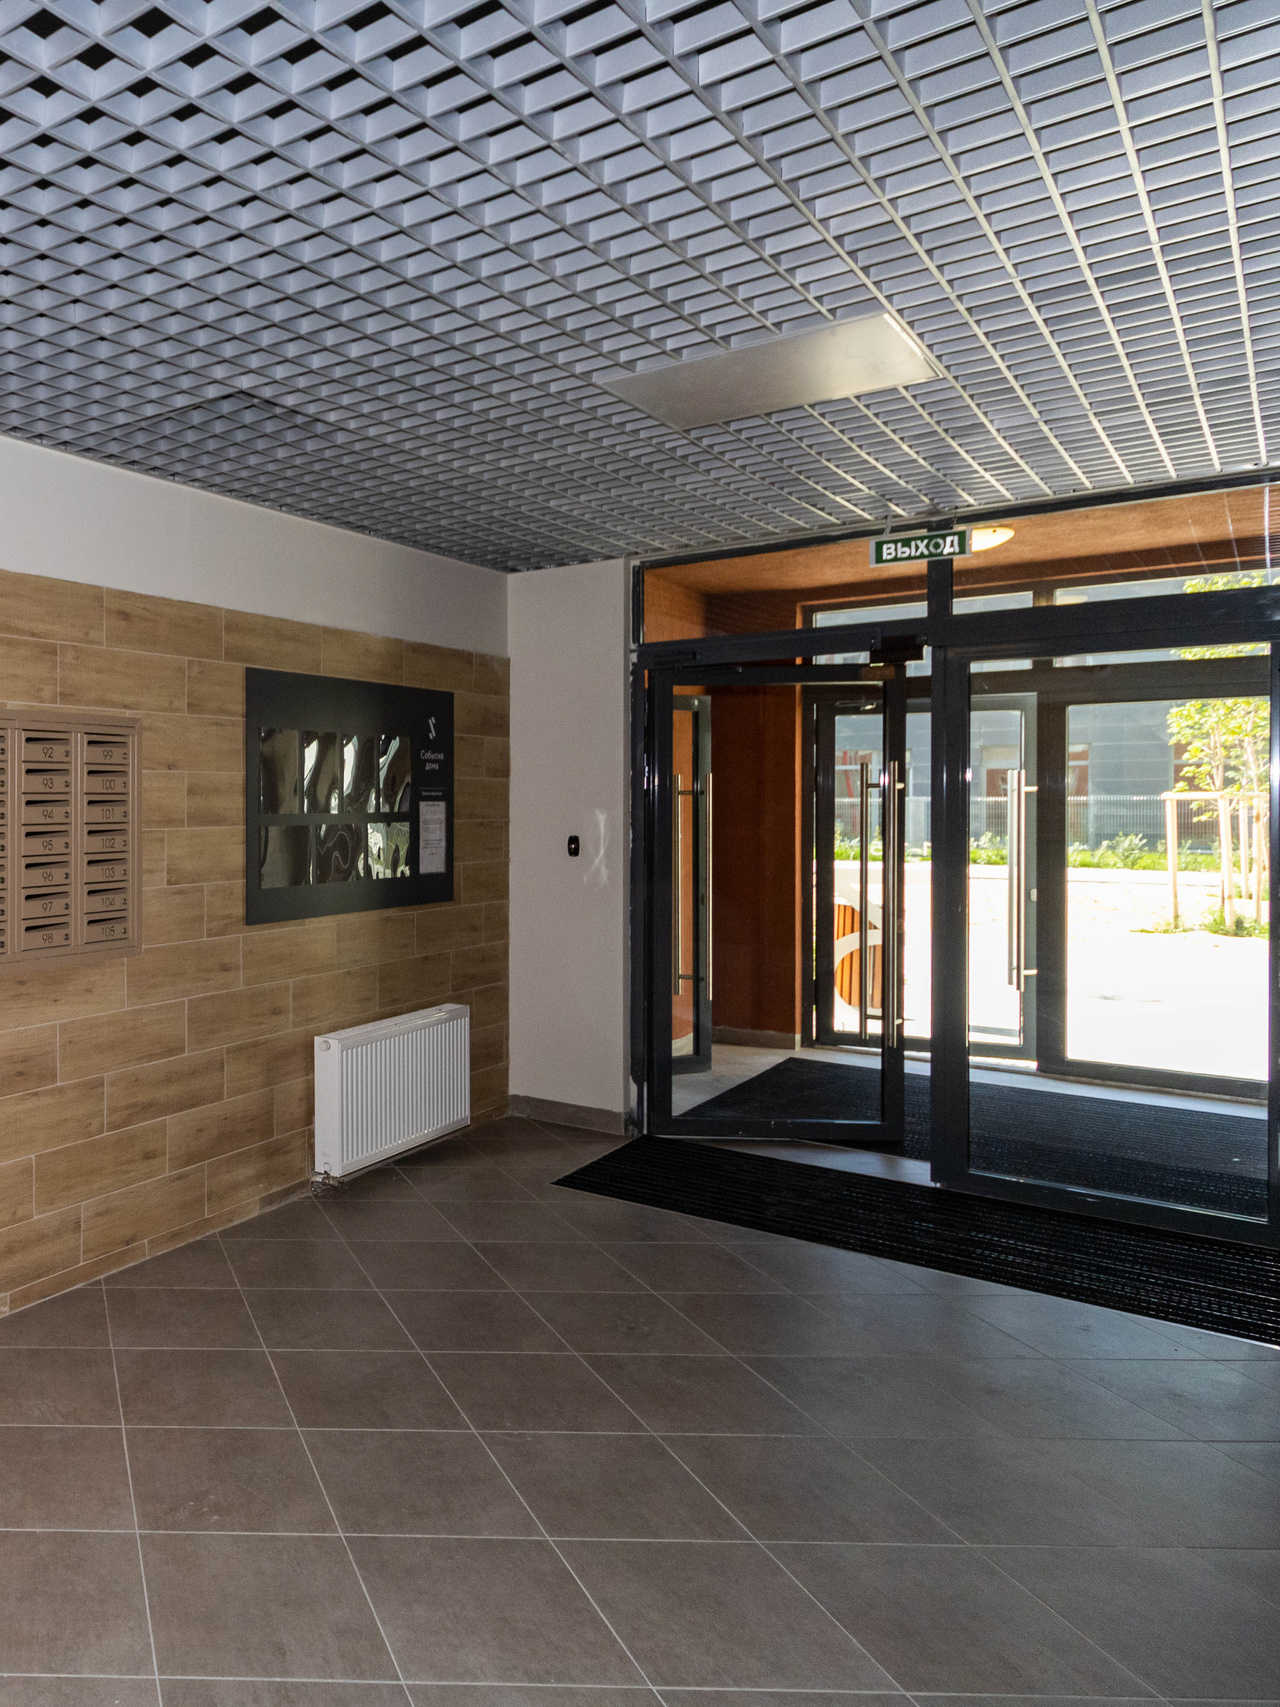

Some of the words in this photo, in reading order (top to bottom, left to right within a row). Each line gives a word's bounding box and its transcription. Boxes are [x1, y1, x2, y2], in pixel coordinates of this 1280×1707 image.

[882, 535, 959, 560] ВЫХОД
[42, 747, 53, 758] 92
[103, 750, 113, 760] 99
[420, 750, 444, 760] События
[425, 762, 439, 770] дома
[43, 778, 53, 789] 93
[101, 779, 115, 789] 100
[42, 809, 54, 819] 94
[101, 809, 114, 819] 101
[42, 840, 53, 851] 95
[101, 838, 115, 849] 102
[42, 872, 53, 882] 96
[101, 868, 115, 878] 103
[101, 897, 115, 907] 104
[42, 902, 53, 913] 97
[101, 926, 115, 936] 105
[42, 933, 53, 944] 98
